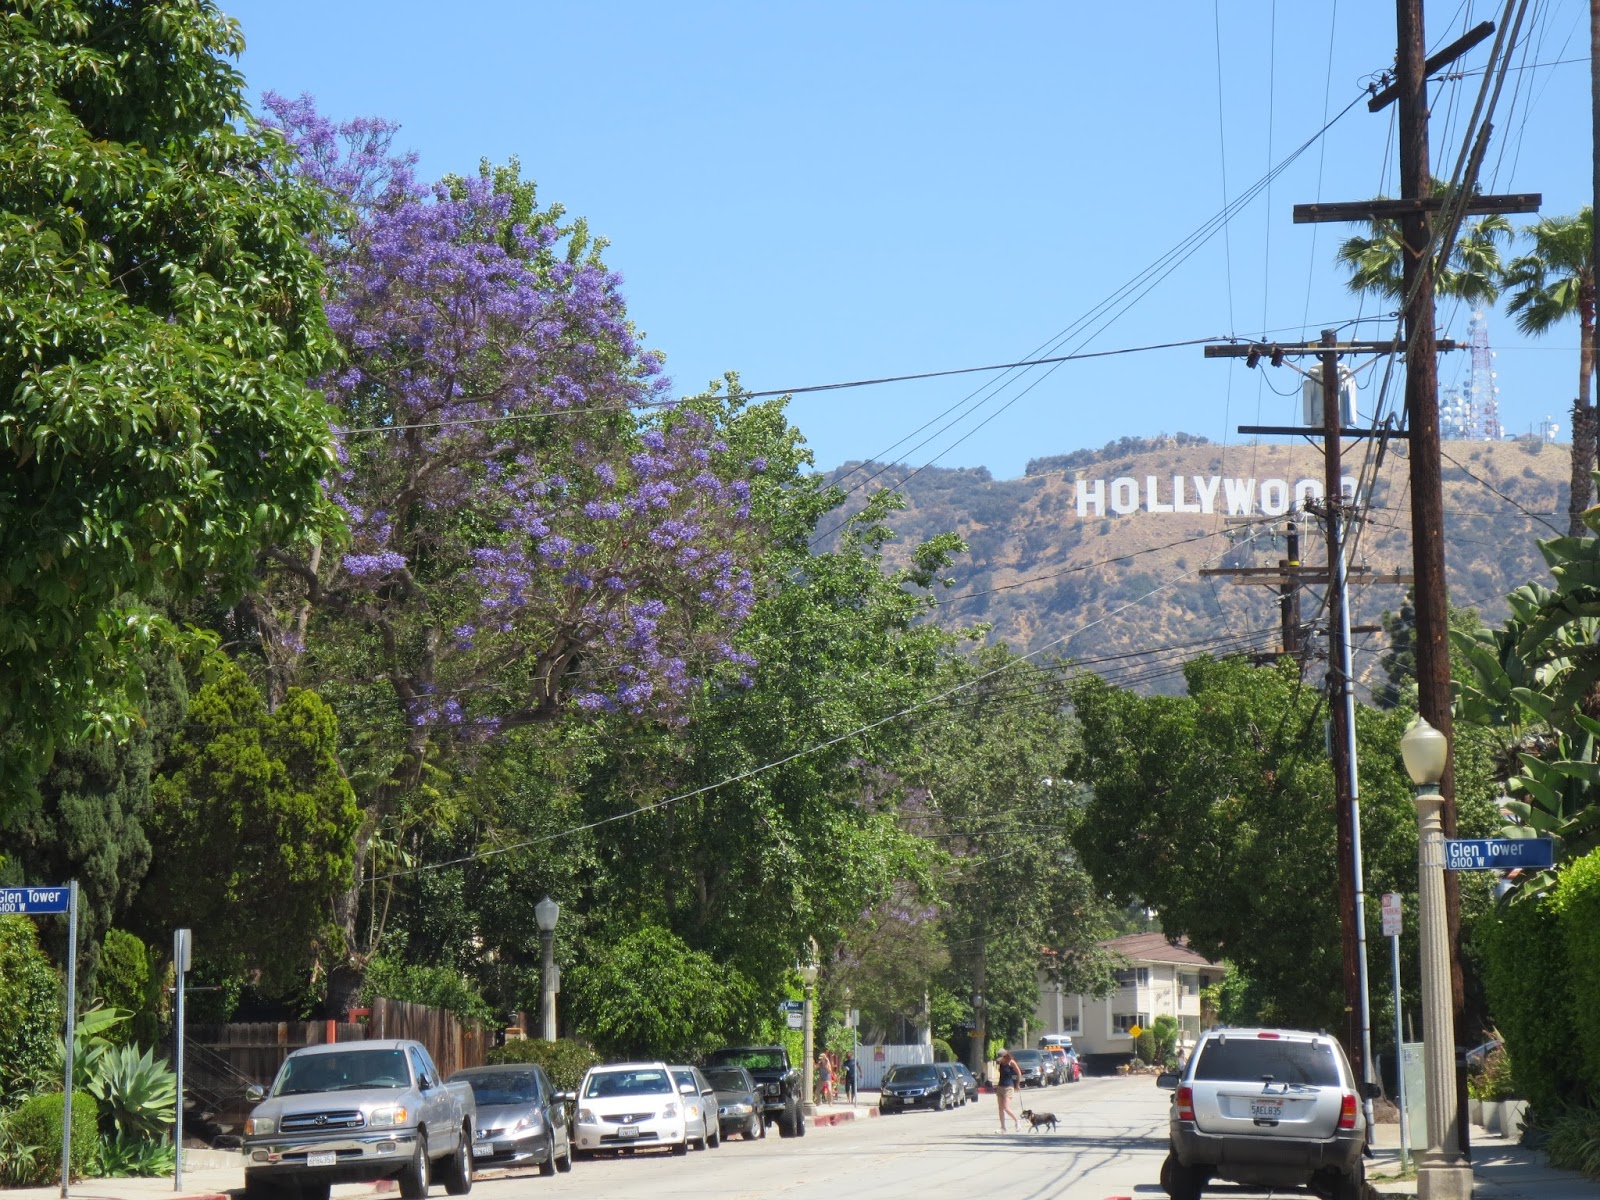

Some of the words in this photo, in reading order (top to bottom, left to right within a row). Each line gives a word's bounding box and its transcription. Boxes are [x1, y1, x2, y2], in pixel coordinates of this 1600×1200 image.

[1450, 842, 1479, 857] Glen
[1485, 841, 1524, 856] Tower
[1451, 857, 1473, 868] 6100
[1477, 857, 1485, 867] W
[27, 890, 61, 903] Tower
[0, 903, 16, 912] 100
[19, 902, 26, 911] W
[1251, 1105, 1281, 1116] 5AEL835
